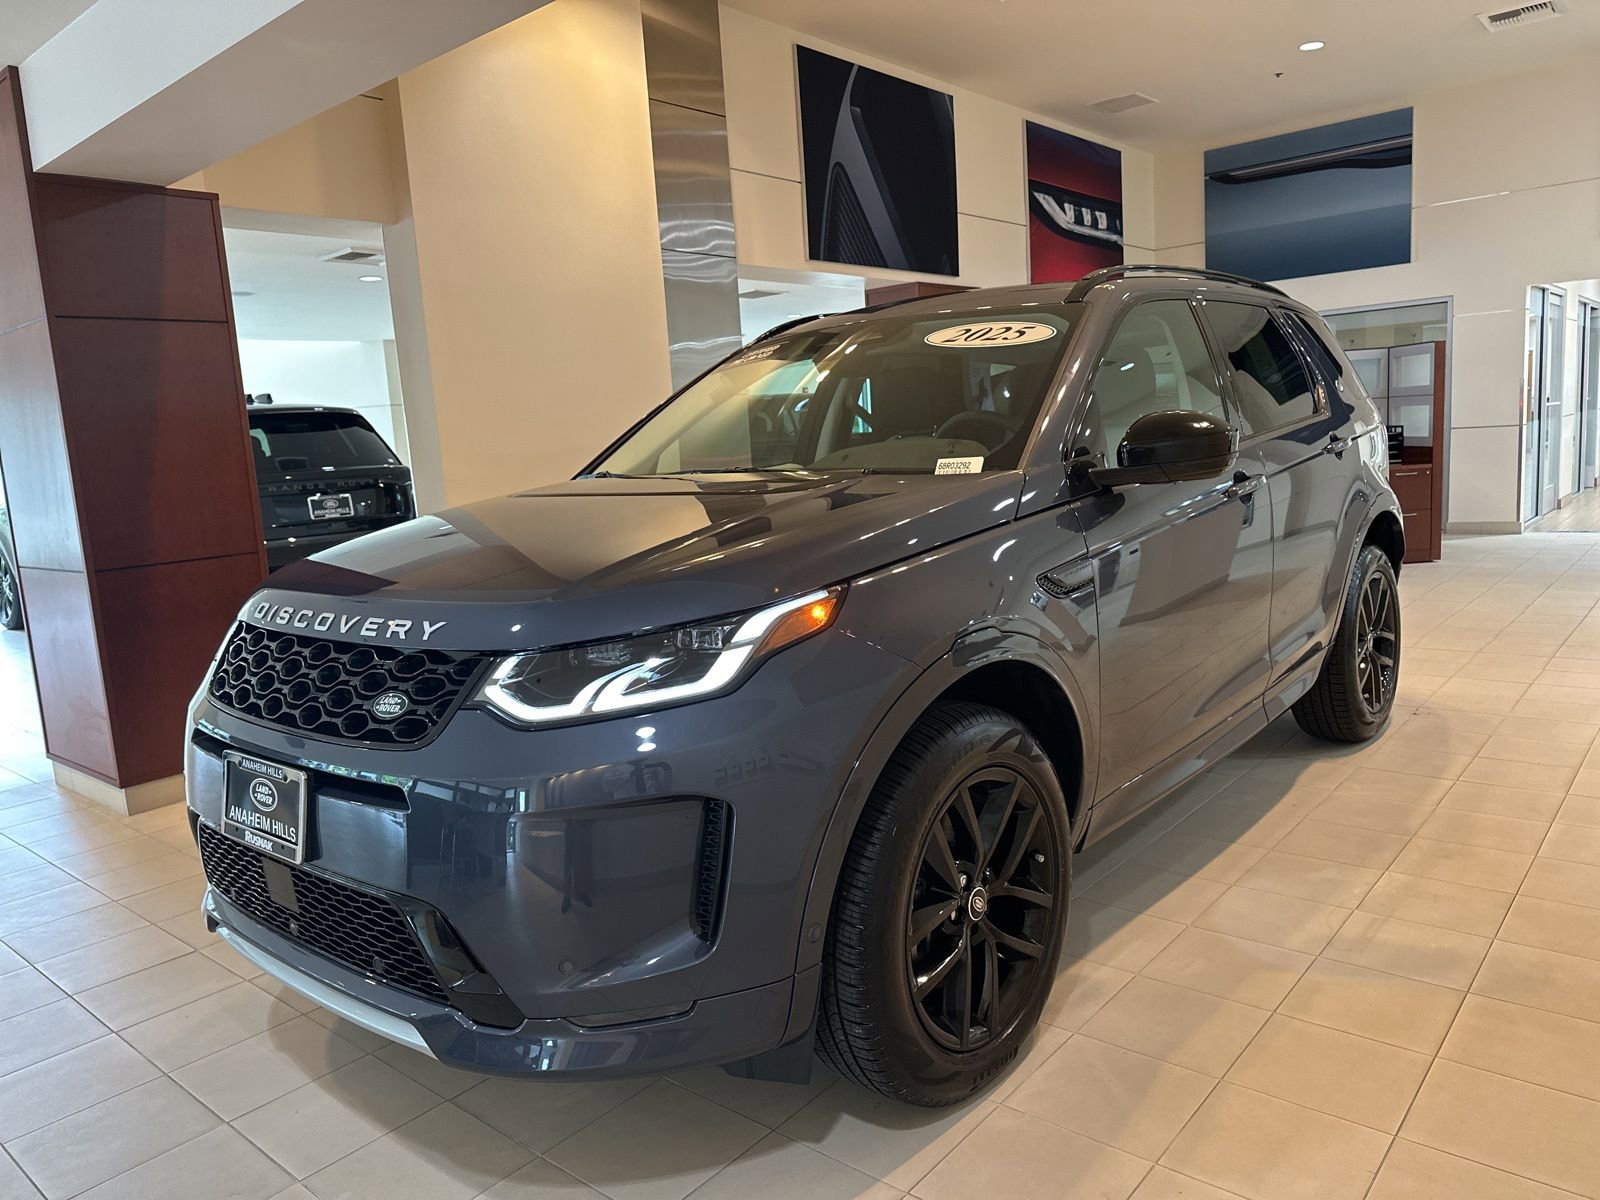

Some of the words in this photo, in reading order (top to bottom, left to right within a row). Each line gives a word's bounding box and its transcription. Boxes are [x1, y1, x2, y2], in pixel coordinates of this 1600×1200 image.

[941, 326, 1036, 343] 2025
[254, 602, 447, 641] DISCOVERY
[378, 704, 400, 712] ROVER
[380, 696, 398, 704] LAND
[242, 759, 267, 774] ANAHEIM
[267, 766, 283, 779] HILLS
[256, 783, 269, 795] LAND
[256, 794, 273, 805] ROVER
[229, 805, 271, 832] ANAHEIM
[272, 819, 297, 843] HILLS
[244, 830, 273, 851] RUSNAK
